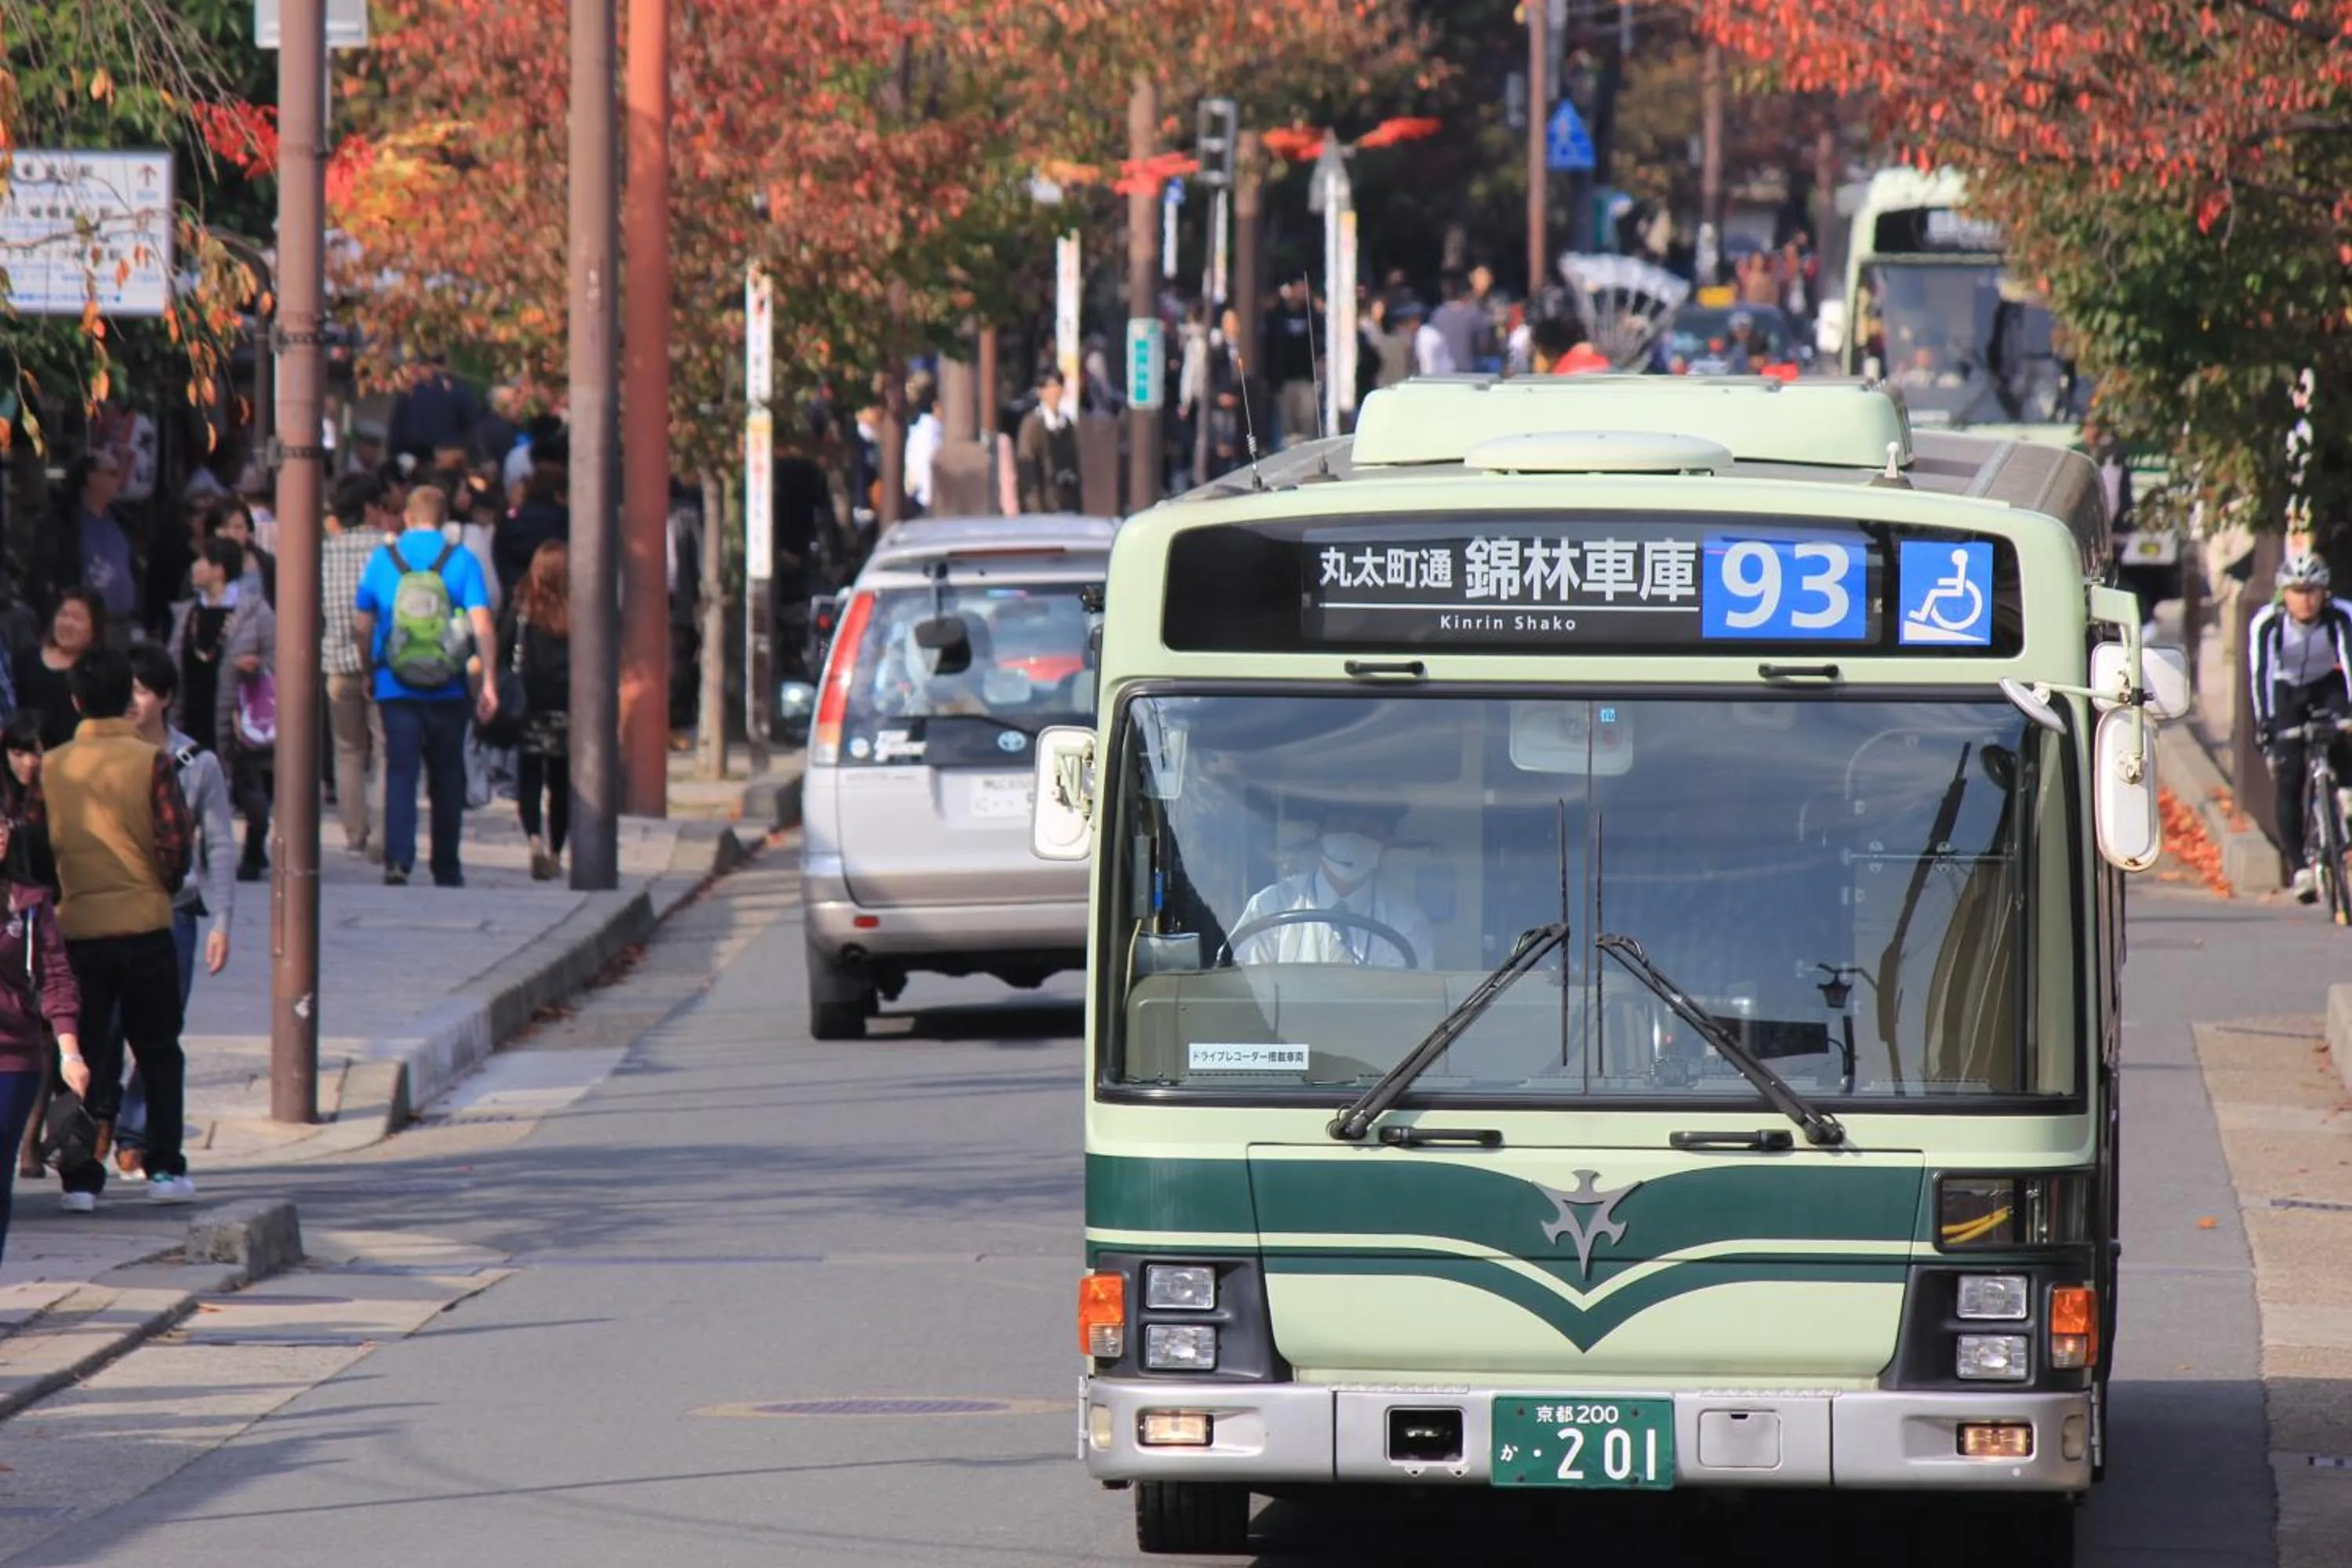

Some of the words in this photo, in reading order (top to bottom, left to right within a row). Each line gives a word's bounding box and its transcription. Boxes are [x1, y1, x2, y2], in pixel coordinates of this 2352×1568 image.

[1319, 546, 1454, 590] 丸太町通
[1465, 535, 1697, 603] 錦林車庫
[1721, 540, 1850, 629] 93
[1440, 615, 1504, 630] Kinrin
[1515, 615, 1577, 632] Shako
